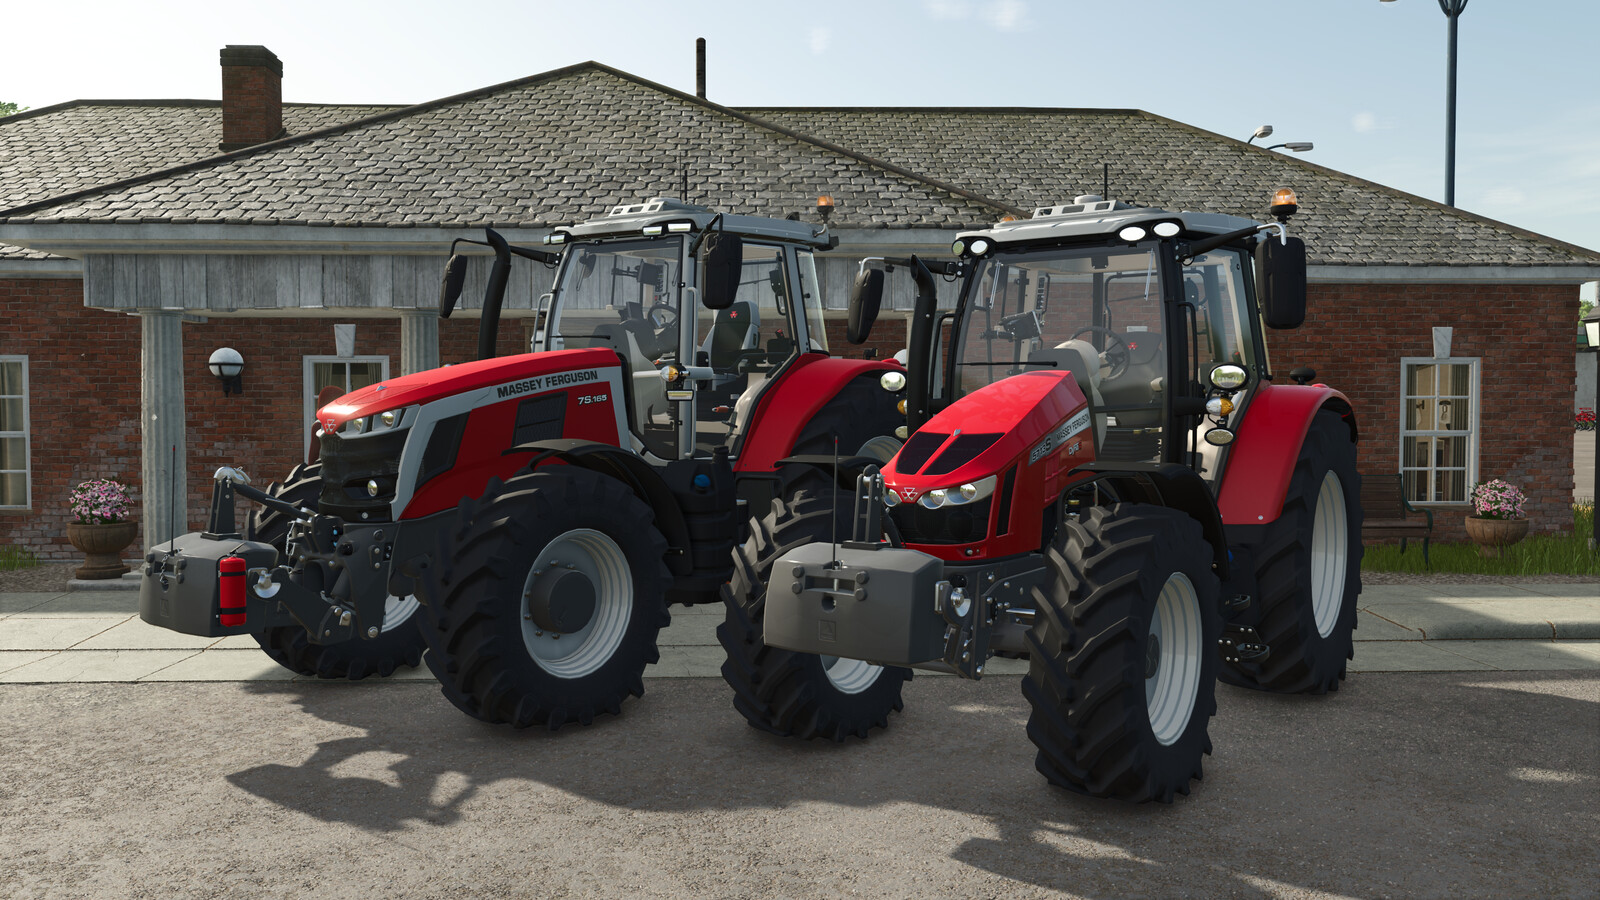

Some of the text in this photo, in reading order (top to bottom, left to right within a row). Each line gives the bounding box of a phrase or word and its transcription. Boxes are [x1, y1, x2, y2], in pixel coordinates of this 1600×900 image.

[497, 370, 598, 398] MASSEY FERGUSON
[577, 394, 608, 405] 7S.165
[1056, 425, 1072, 441] MASSEY
